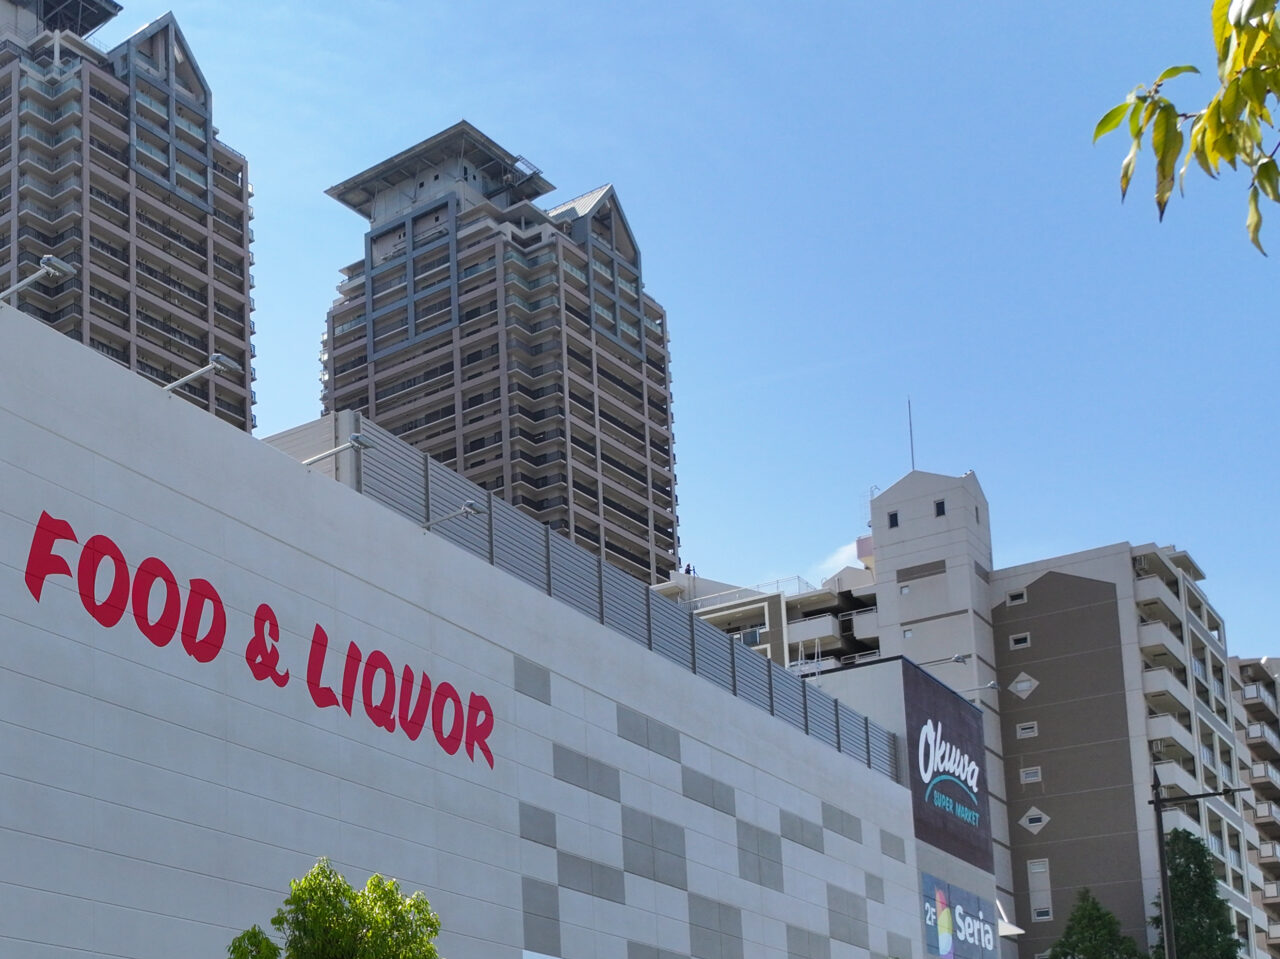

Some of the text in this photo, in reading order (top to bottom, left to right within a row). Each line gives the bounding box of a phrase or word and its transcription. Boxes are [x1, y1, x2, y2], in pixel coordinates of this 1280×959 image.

[25, 509, 494, 770] FOOD & LIQUOR
[918, 719, 979, 793] Okuwa
[933, 790, 980, 828] SUPER MARKET
[924, 902, 994, 951] 2F Seria
